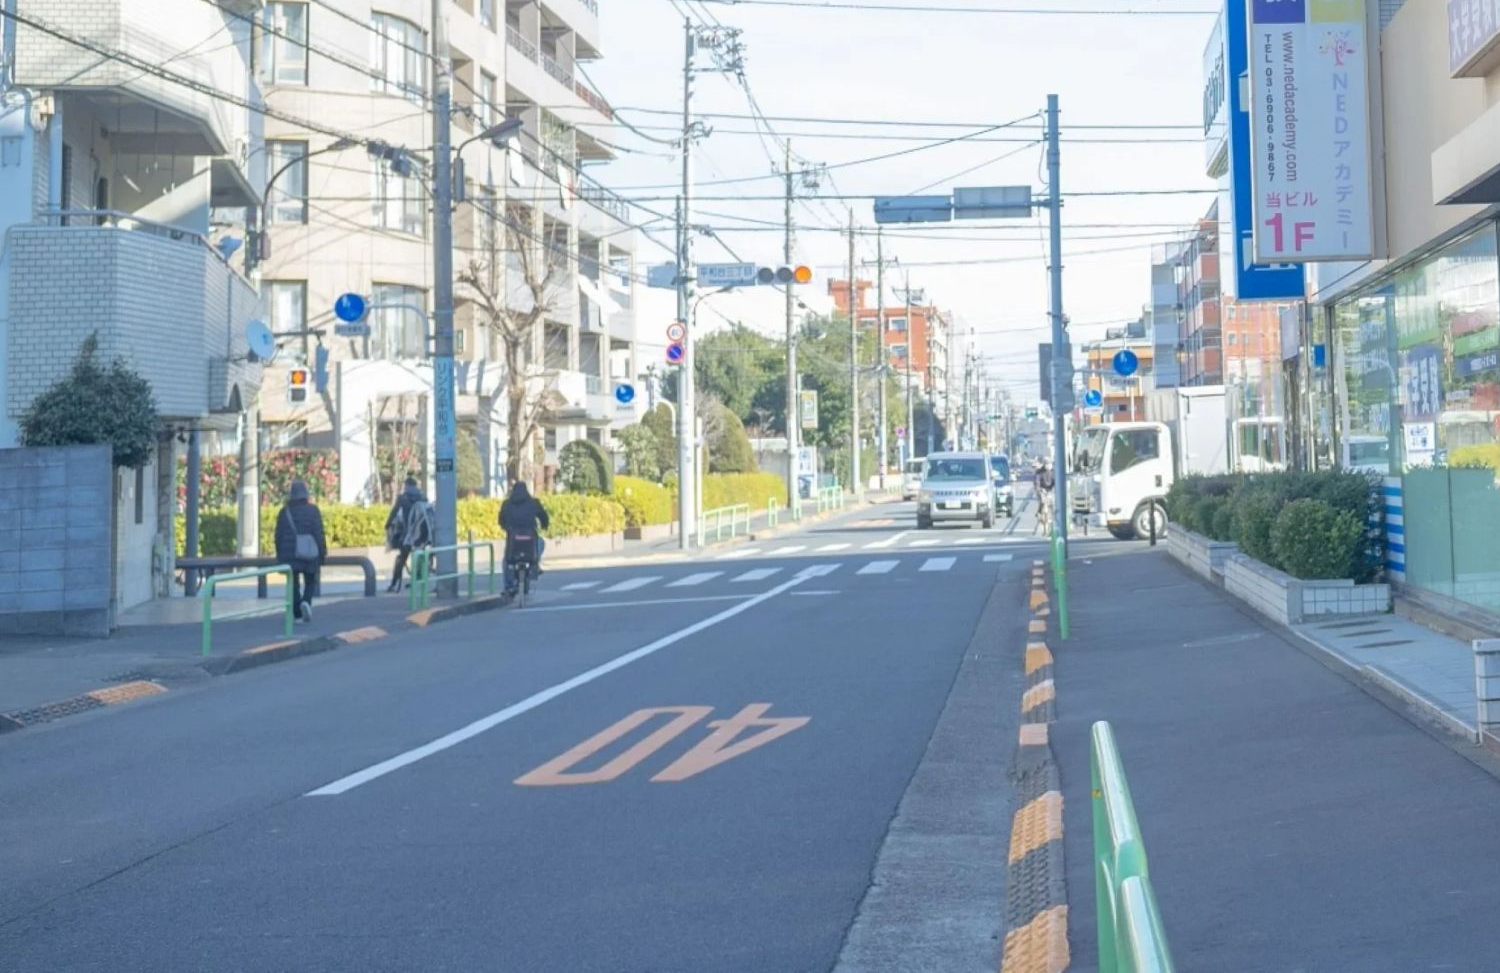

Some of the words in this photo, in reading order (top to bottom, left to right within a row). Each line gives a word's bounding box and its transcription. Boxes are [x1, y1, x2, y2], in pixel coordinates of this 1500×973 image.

[1263, 33, 1273, 63] TEL
[1282, 31, 1298, 182] www.nedacademy.com
[1332, 72, 1354, 249] NEDアカデミー
[1265, 190, 1319, 209] 当ビル
[1264, 212, 1317, 253] 1F
[511, 702, 813, 786] 40
